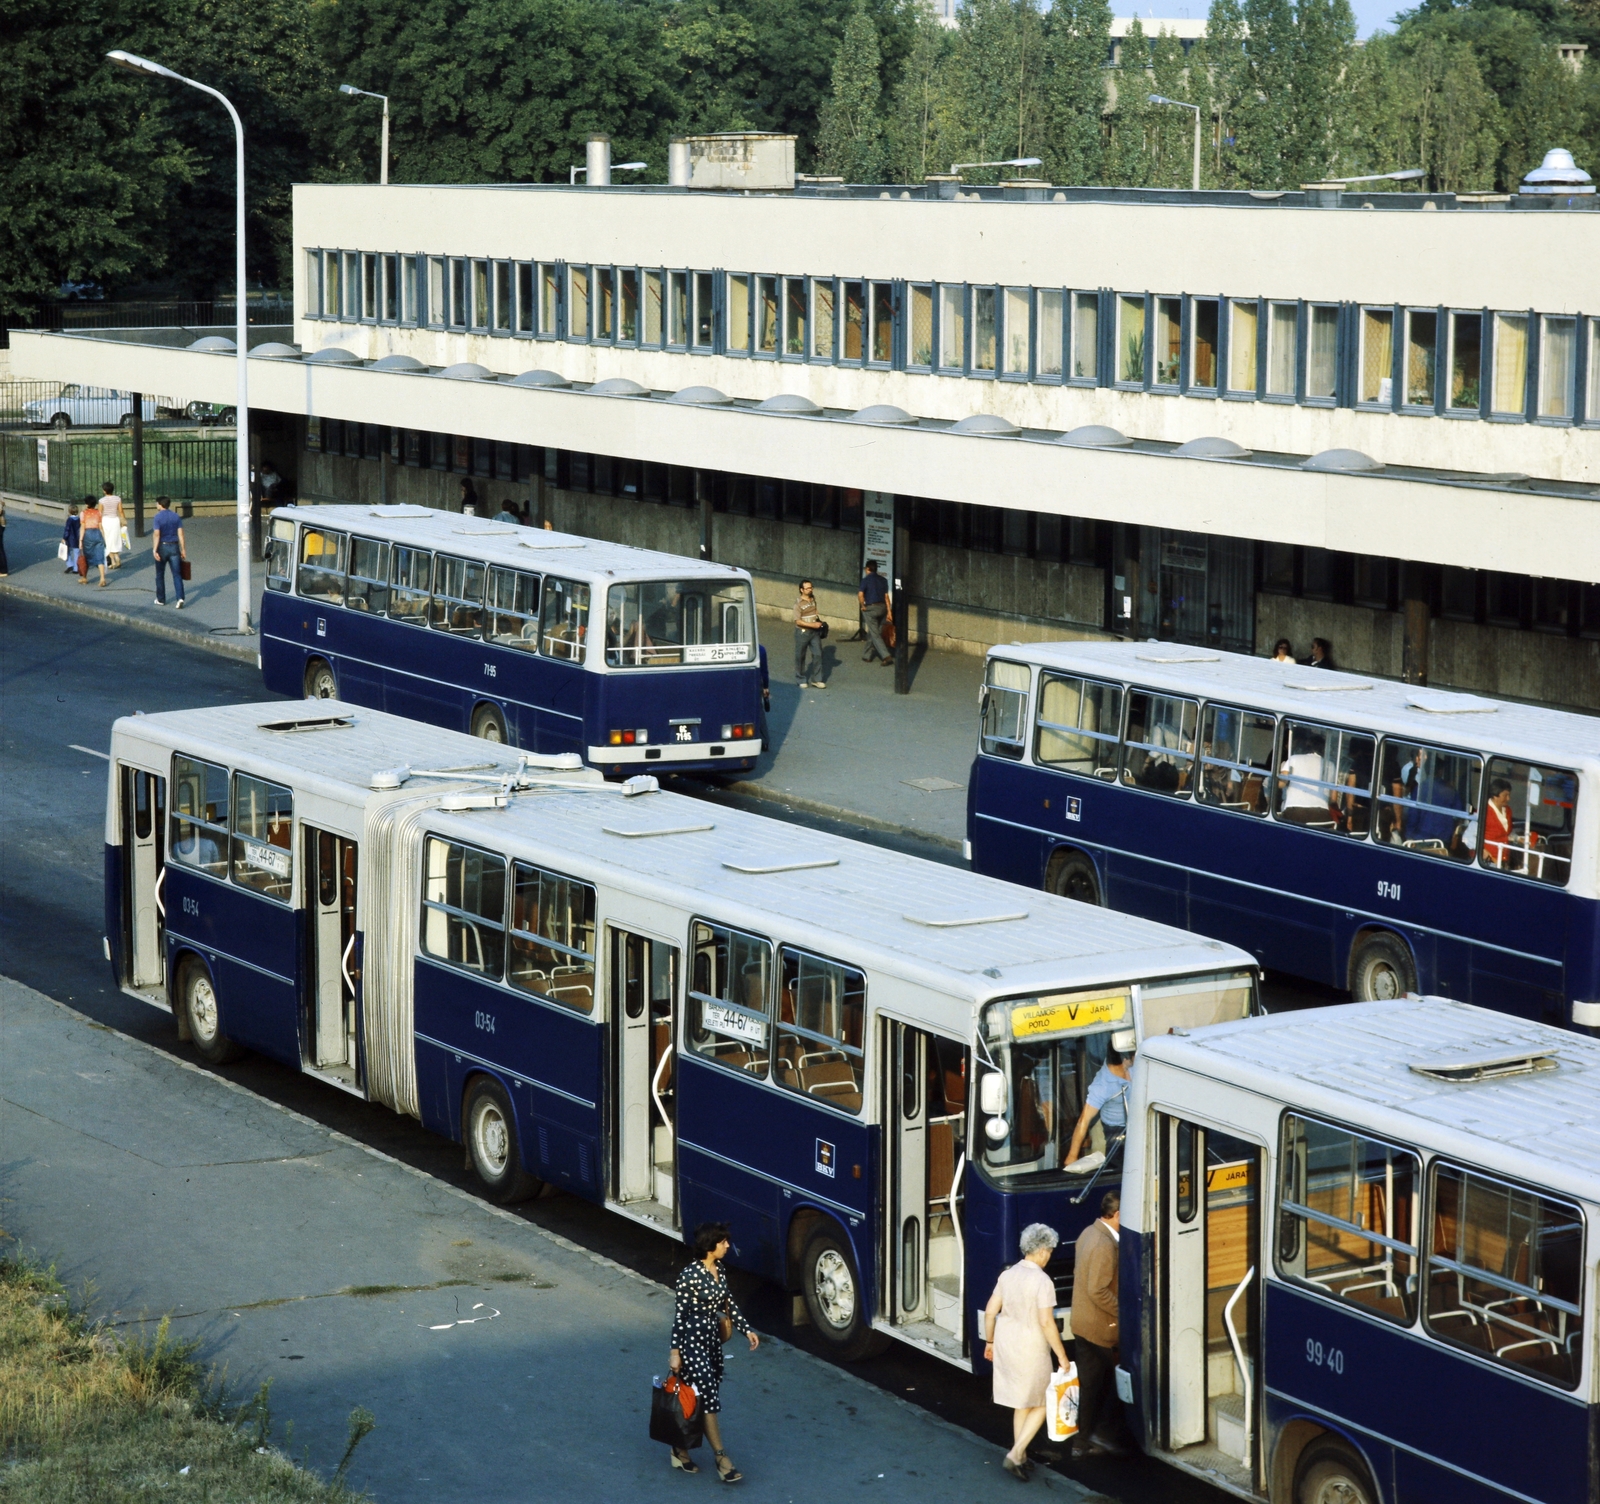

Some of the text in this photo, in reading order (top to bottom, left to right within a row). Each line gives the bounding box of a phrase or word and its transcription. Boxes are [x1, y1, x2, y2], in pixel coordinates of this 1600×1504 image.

[711, 649, 724, 659] 25
[484, 663, 496, 677] 71-95
[259, 848, 275, 866] 44-67
[1377, 880, 1401, 901] 97-01
[183, 896, 199, 917] 03-54
[724, 1010, 747, 1031] 44-67
[1023, 1008, 1060, 1019] VILLAMOS-
[1067, 1004, 1079, 1021] V
[475, 1010, 495, 1034] 03-54
[817, 1163, 834, 1176] BKV
[1306, 1338, 1344, 1375] 99-40
